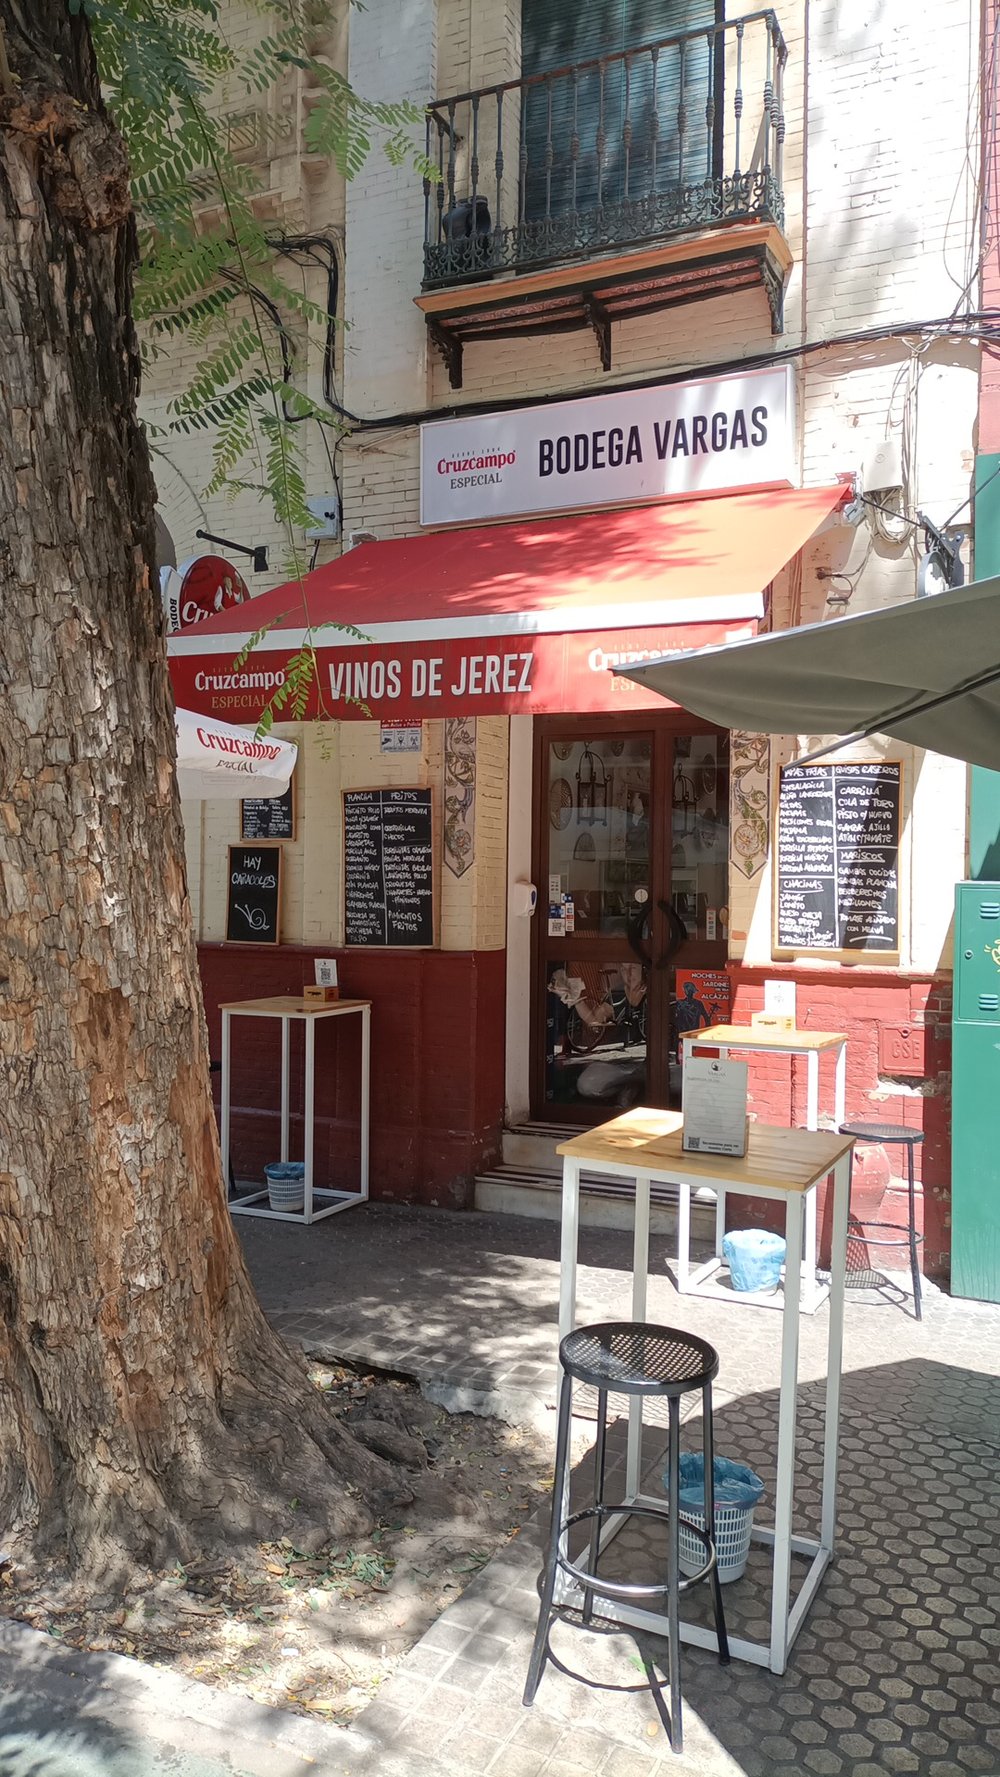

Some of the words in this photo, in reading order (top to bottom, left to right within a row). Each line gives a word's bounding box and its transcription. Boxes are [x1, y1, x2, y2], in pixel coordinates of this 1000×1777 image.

[539, 425, 643, 477] BODEGA
[653, 406, 768, 460] VARGAS
[437, 451, 515, 475] Cruzcampo
[450, 472, 502, 490] ESPECIAL
[195, 671, 285, 691] Cruzcampo
[328, 660, 401, 700] VINOS
[411, 658, 443, 698] DE
[451, 652, 533, 697] JEREZ
[211, 694, 268, 709] ESPECIAL
[196, 728, 281, 760] Cruzcampo
[861, 765, 899, 776] CASEROS
[838, 798, 857, 806] COLA
[872, 798, 894, 808] TORO
[837, 808, 858, 819] PISTO
[841, 850, 884, 861] MARISCOS
[243, 856, 261, 871] HAY
[784, 879, 823, 889] CHACINAS
